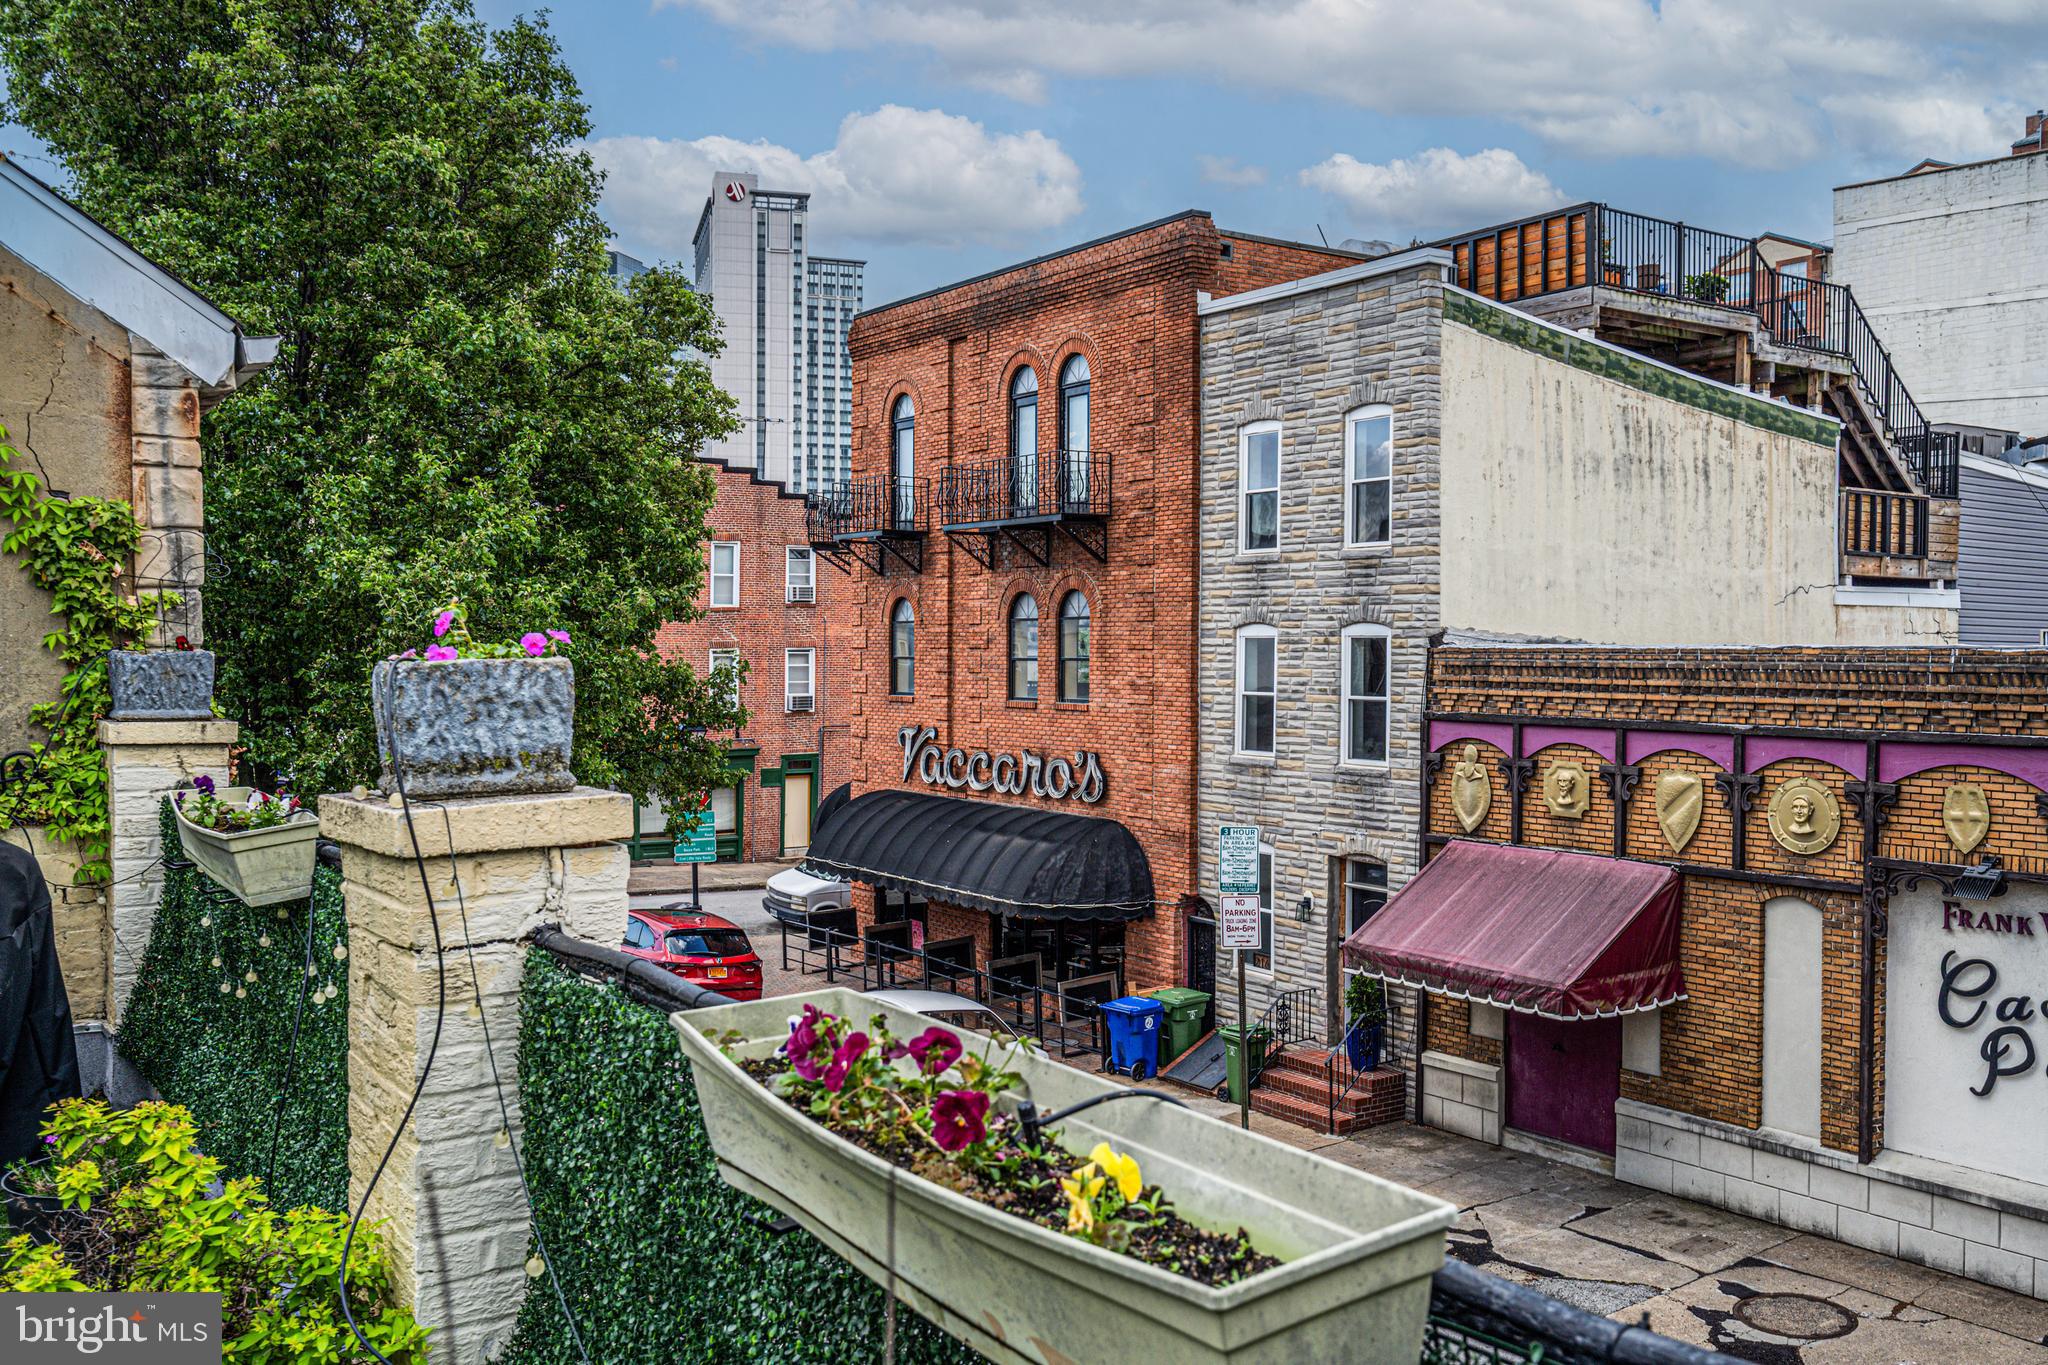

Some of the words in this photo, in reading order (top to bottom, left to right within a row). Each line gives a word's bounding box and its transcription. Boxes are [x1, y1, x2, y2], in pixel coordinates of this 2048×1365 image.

[898, 725, 1107, 803] Vaccaro's
[1226, 924, 1256, 932] 8AM-6PM
[1942, 901, 2034, 936] FRANK
[1938, 950, 2048, 1028] Ca
